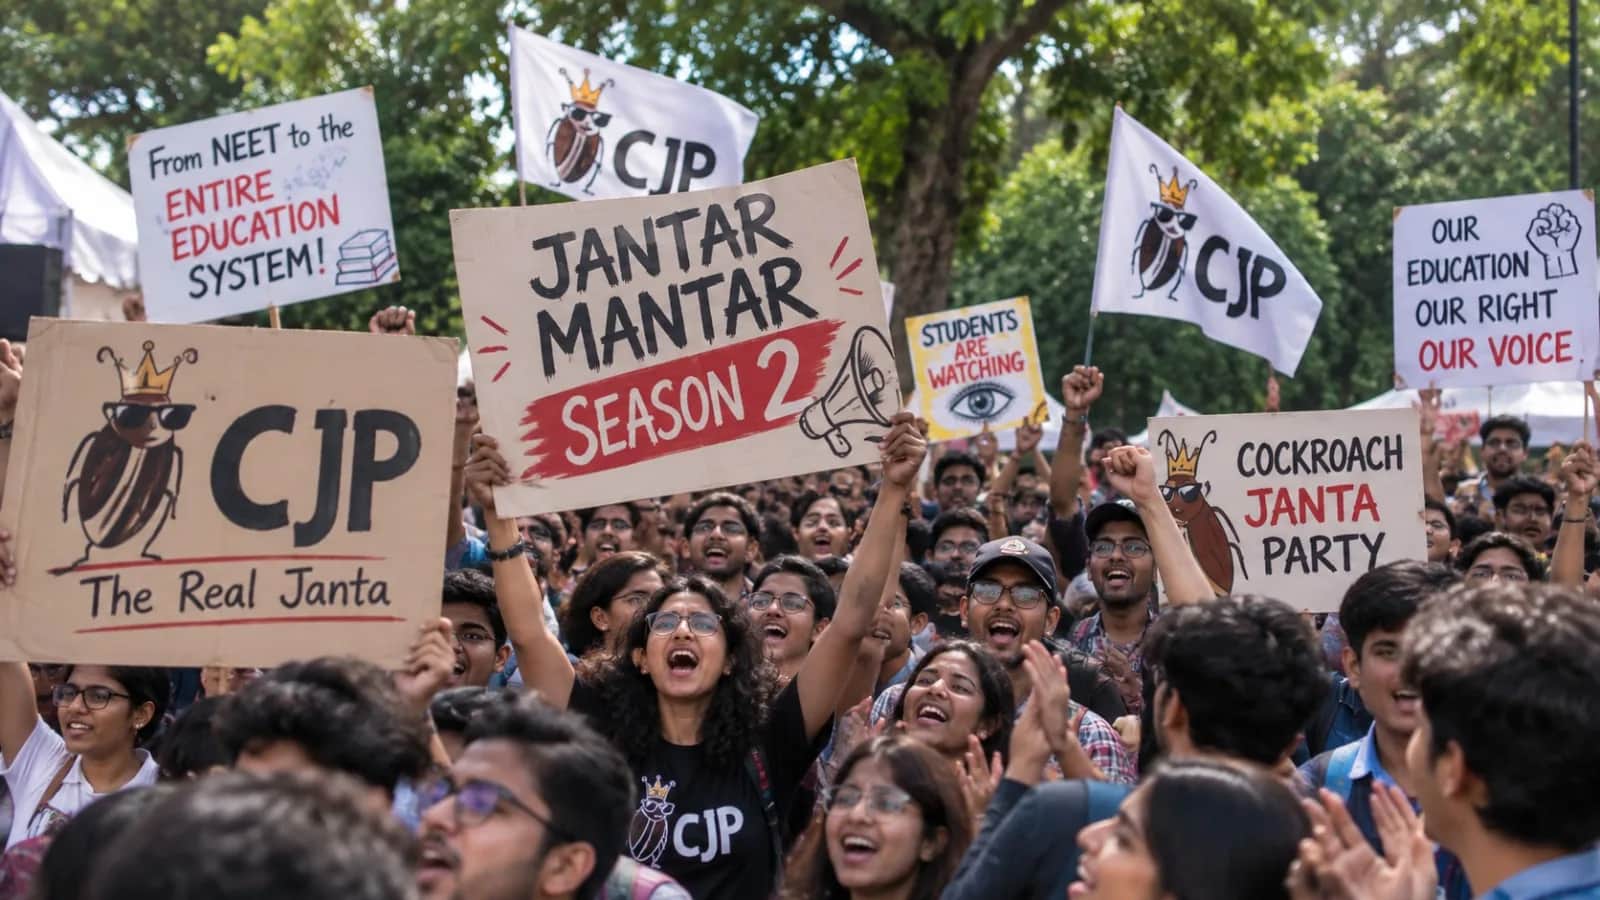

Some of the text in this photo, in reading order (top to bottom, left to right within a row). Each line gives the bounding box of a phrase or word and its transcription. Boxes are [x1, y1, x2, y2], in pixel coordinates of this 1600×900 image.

[149, 113, 355, 180] From NEET to the
[613, 129, 717, 196] CJP
[165, 170, 275, 222] ENTIRE
[171, 194, 340, 262] EDUCATION
[530, 193, 795, 300] JANTAR
[1432, 215, 1480, 244] OUR
[189, 237, 326, 299] SYSTEM!
[1195, 235, 1287, 320] CJP
[1407, 250, 1529, 286] EDUCATION
[536, 256, 819, 379] MANTAR
[922, 309, 1018, 347] STUDENTS
[1415, 289, 1558, 327] OUR RIGHT
[928, 351, 1025, 389] WATCHING
[954, 337, 989, 361] ARE
[1418, 330, 1573, 371] OUR VOICE
[561, 339, 814, 466] SEASON 2
[210, 404, 422, 548] CJP
[1237, 434, 1403, 477] COCKROACH
[1244, 483, 1381, 528] JANTA
[1262, 532, 1386, 576] PARTY
[80, 567, 392, 618] The Real Janta
[673, 805, 744, 863] CJP
